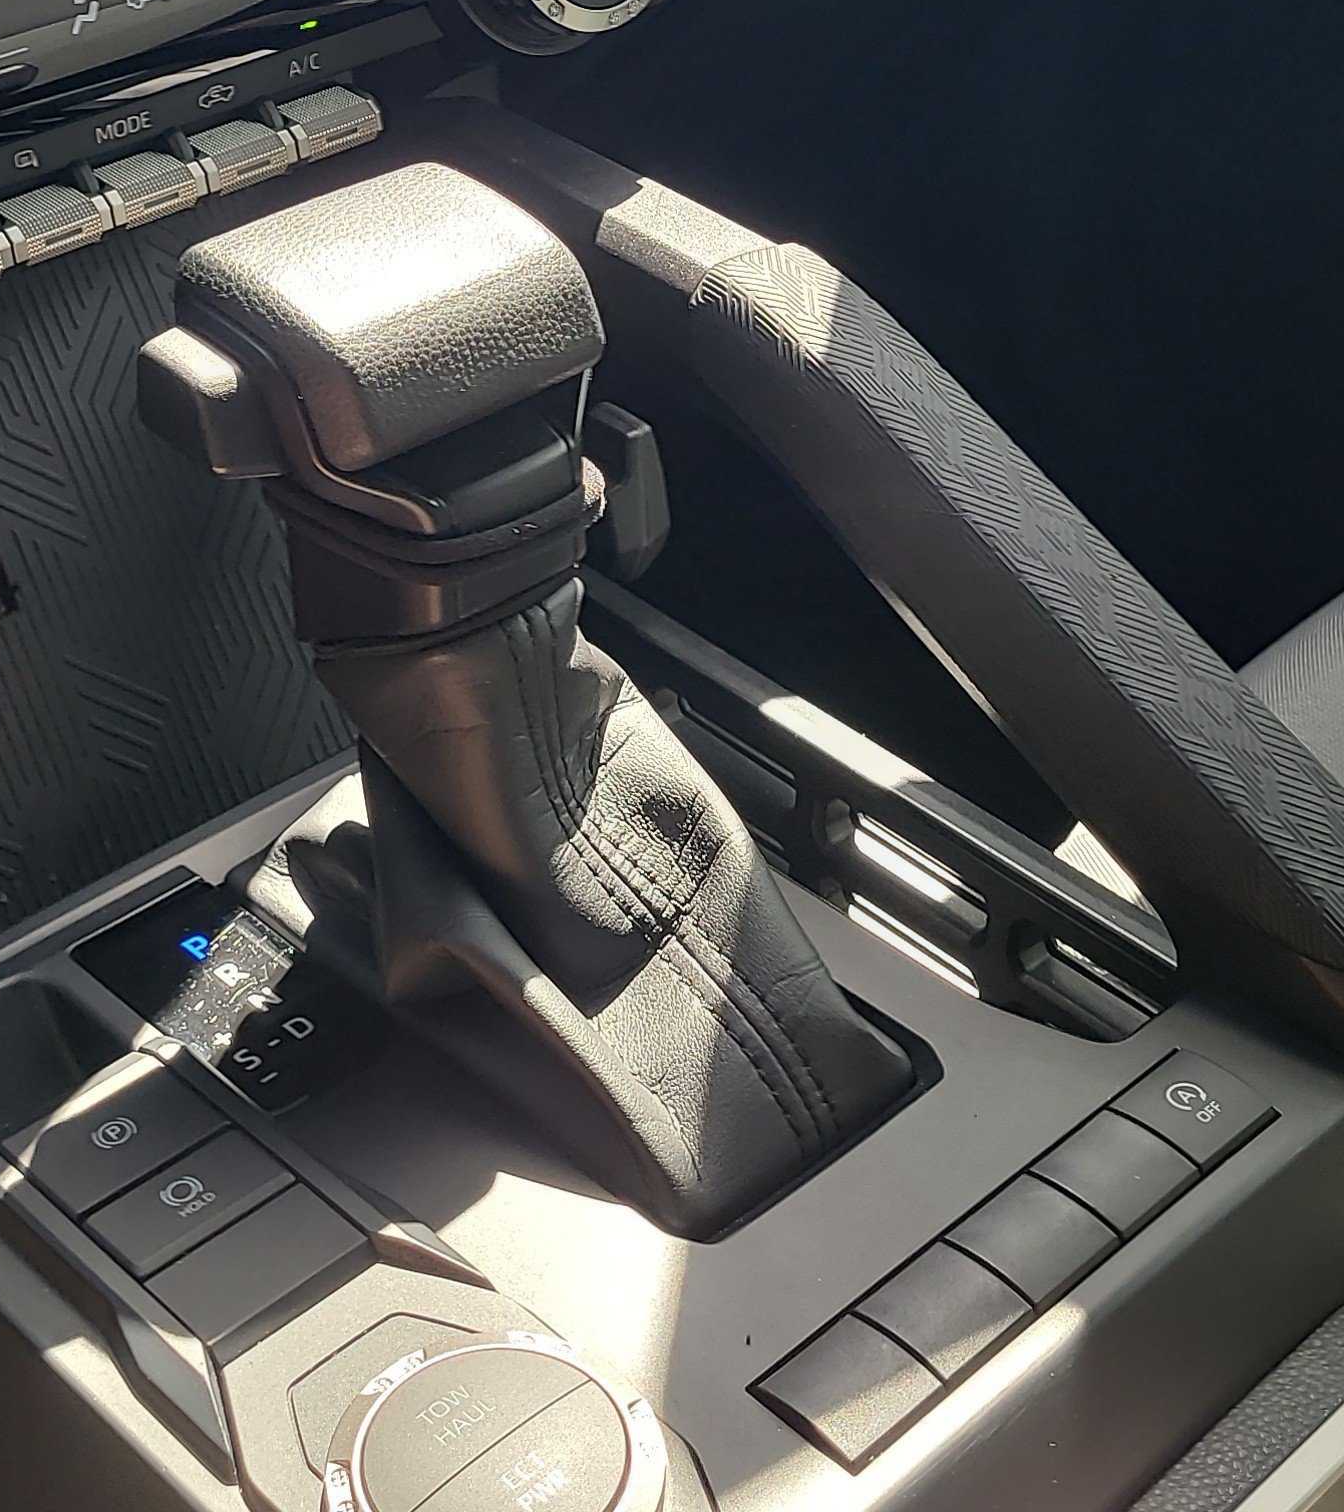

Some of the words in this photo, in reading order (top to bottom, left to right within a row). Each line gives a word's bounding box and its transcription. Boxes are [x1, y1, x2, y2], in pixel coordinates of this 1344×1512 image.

[286, 52, 322, 79] A/C
[94, 110, 154, 145] MODE
[180, 934, 210, 962] P
[212, 962, 252, 988] R
[281, 1016, 316, 1040] D
[232, 1048, 263, 1072] S
[1196, 1100, 1222, 1123] OFF
[177, 1191, 216, 1218] HOLD
[415, 1384, 472, 1426] TOW
[433, 1399, 497, 1447] HAUL
